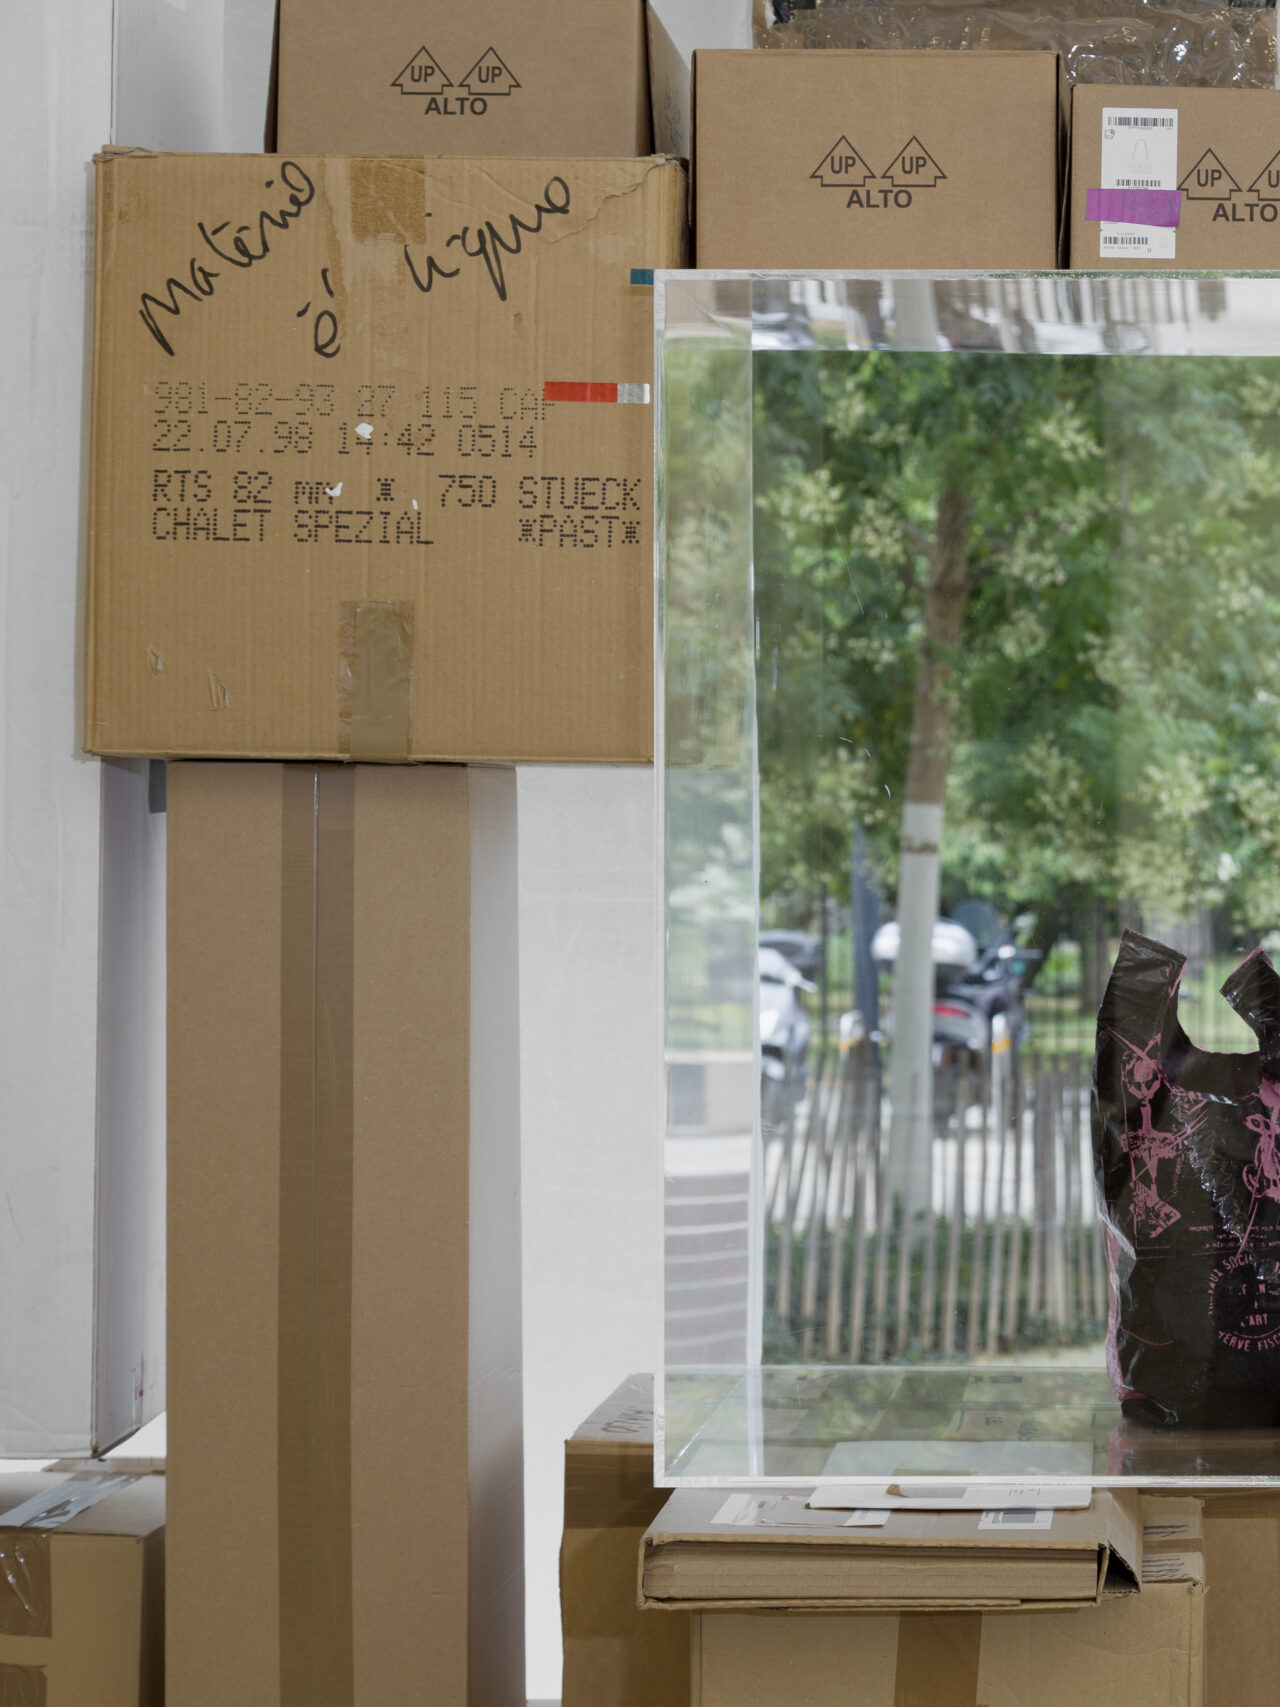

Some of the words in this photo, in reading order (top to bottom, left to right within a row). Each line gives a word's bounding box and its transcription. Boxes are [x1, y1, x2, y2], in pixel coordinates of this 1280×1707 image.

[411, 65, 435, 82] UP
[478, 66, 502, 83] UP
[424, 97, 487, 115] ALTO
[830, 156, 856, 174] UP
[901, 156, 927, 174] UP
[1196, 169, 1222, 187] UP
[846, 189, 912, 208] ALTO
[1211, 203, 1278, 222] ALTO
[421, 385, 477, 419] 115
[152, 419, 313, 454] 22.07.98
[457, 423, 538, 458] 0514
[152, 469, 212, 502] RTS
[232, 470, 273, 504] 82
[438, 474, 497, 507] 750
[518, 475, 642, 511] STUECK
[152, 507, 272, 542] CHALET
[293, 509, 435, 544] SPEZIAL
